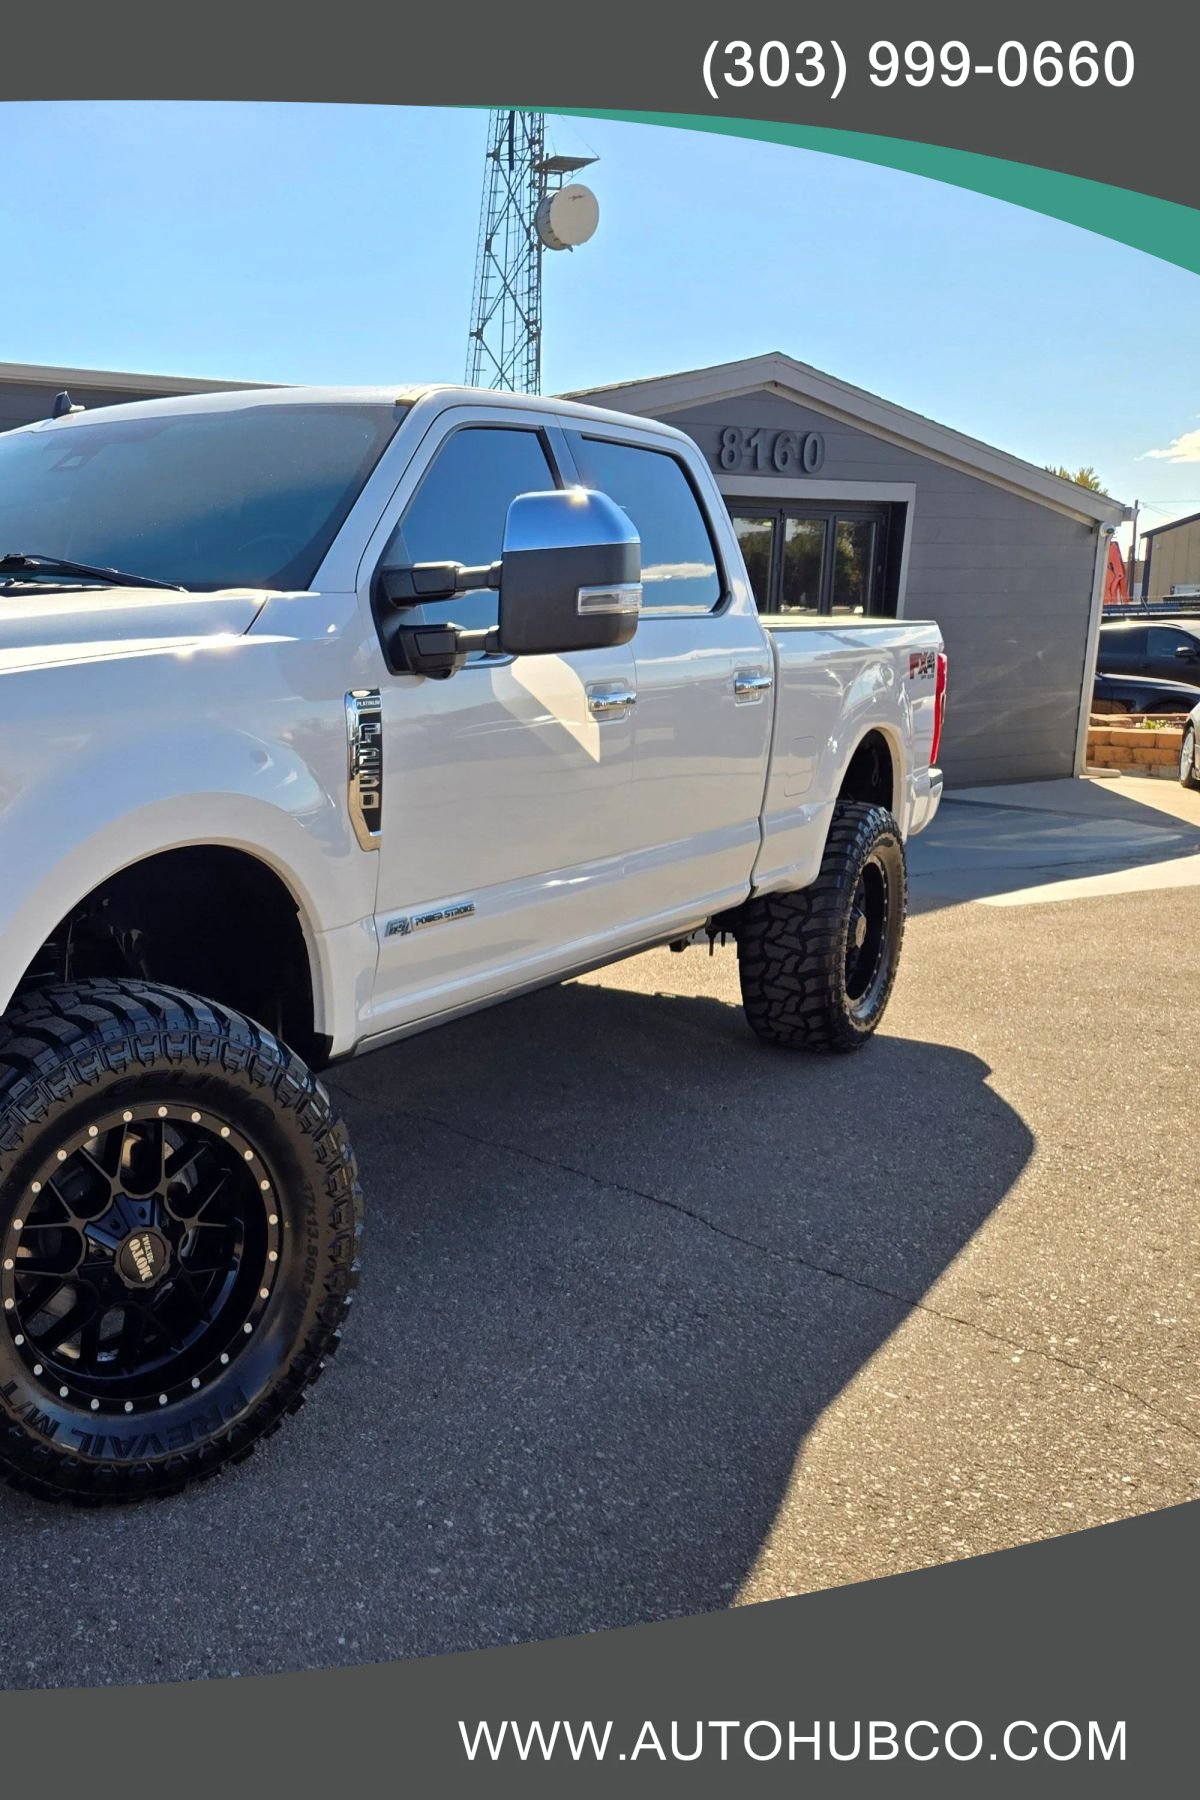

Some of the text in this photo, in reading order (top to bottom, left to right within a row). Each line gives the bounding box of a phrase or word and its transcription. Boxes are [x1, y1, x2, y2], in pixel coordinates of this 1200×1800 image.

[720, 426, 825, 473] 8160
[909, 651, 935, 680] FX4
[415, 903, 476, 926] POWER STROKE
[128, 1238, 153, 1282] MOTO
